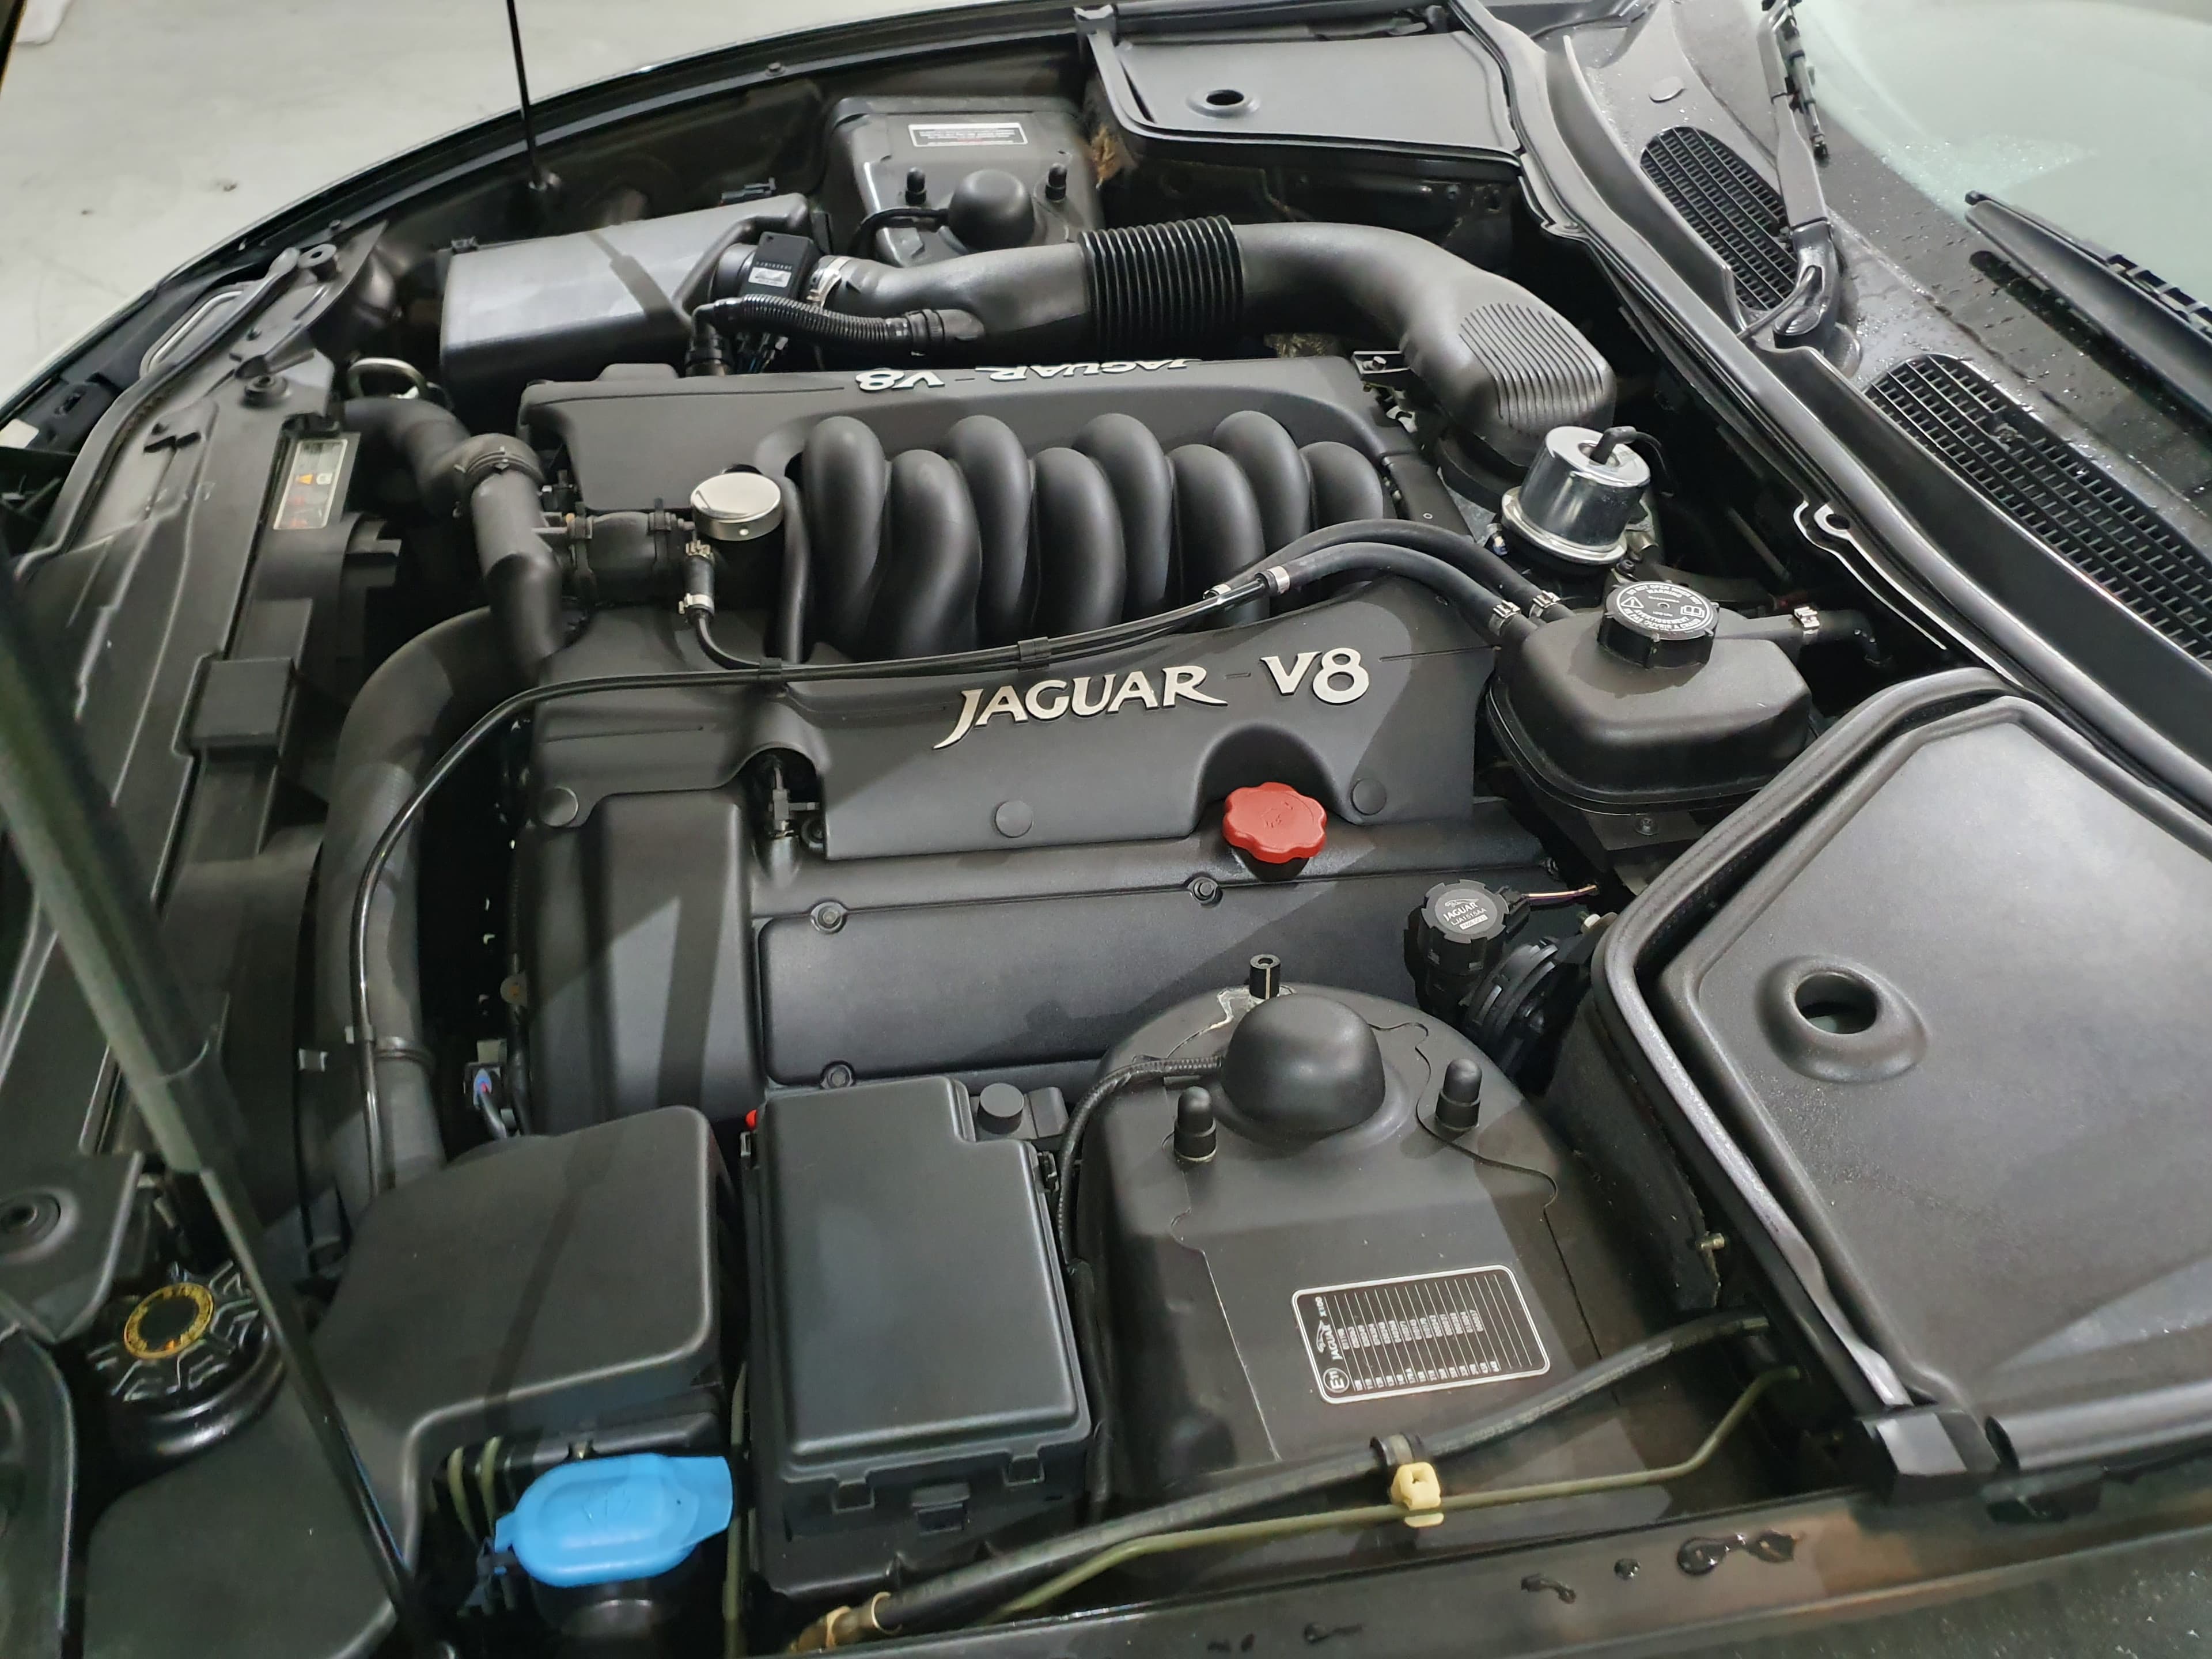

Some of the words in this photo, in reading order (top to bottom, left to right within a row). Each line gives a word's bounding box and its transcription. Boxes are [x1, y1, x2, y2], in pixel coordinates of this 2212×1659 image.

[855, 368, 945, 391] V8
[975, 358, 1202, 381] JAGUAR
[933, 665, 1229, 749] JAGUAR
[1261, 647, 1369, 704] V8
[1443, 902, 1478, 922] JAGUAR
[1323, 1324, 1343, 1360] JAGUAR
